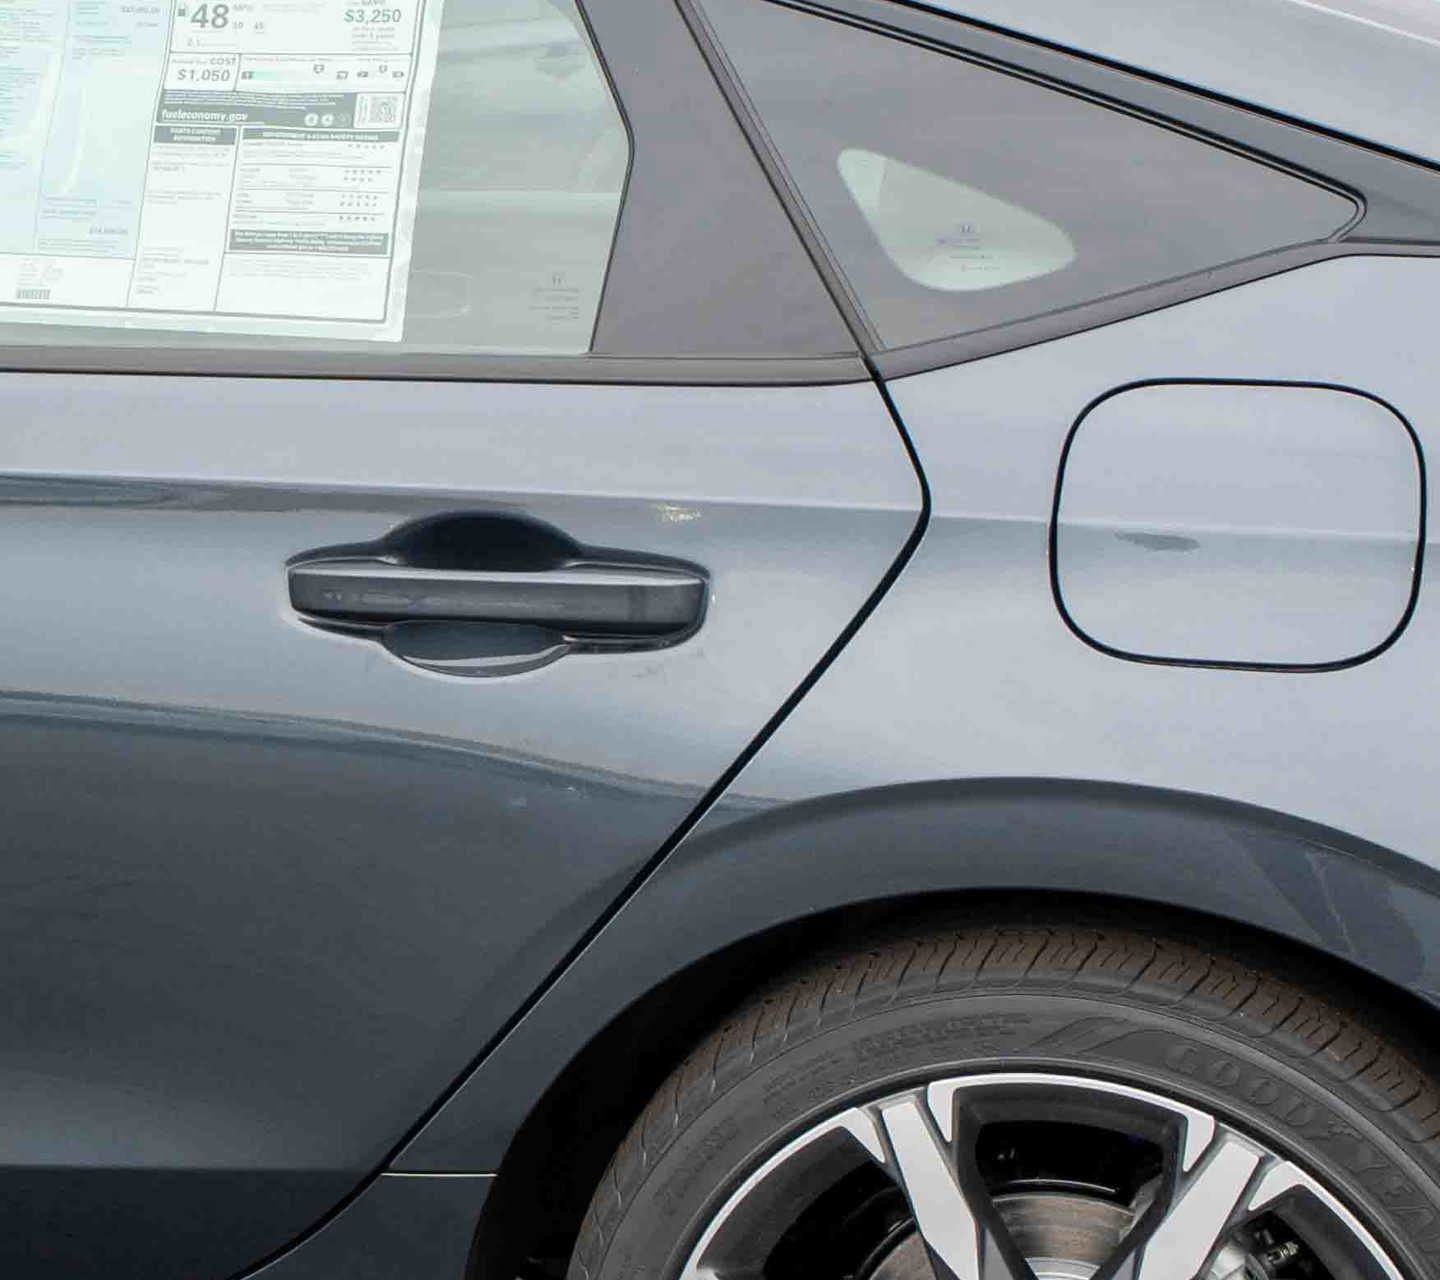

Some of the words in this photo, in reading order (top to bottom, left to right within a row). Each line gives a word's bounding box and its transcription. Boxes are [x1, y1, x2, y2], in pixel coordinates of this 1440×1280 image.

[190, 3, 230, 29] 48
[343, 8, 402, 25] $3,250
[209, 56, 237, 66] COST
[176, 68, 232, 82] $1,050
[161, 108, 249, 122] fueleconomy.gov
